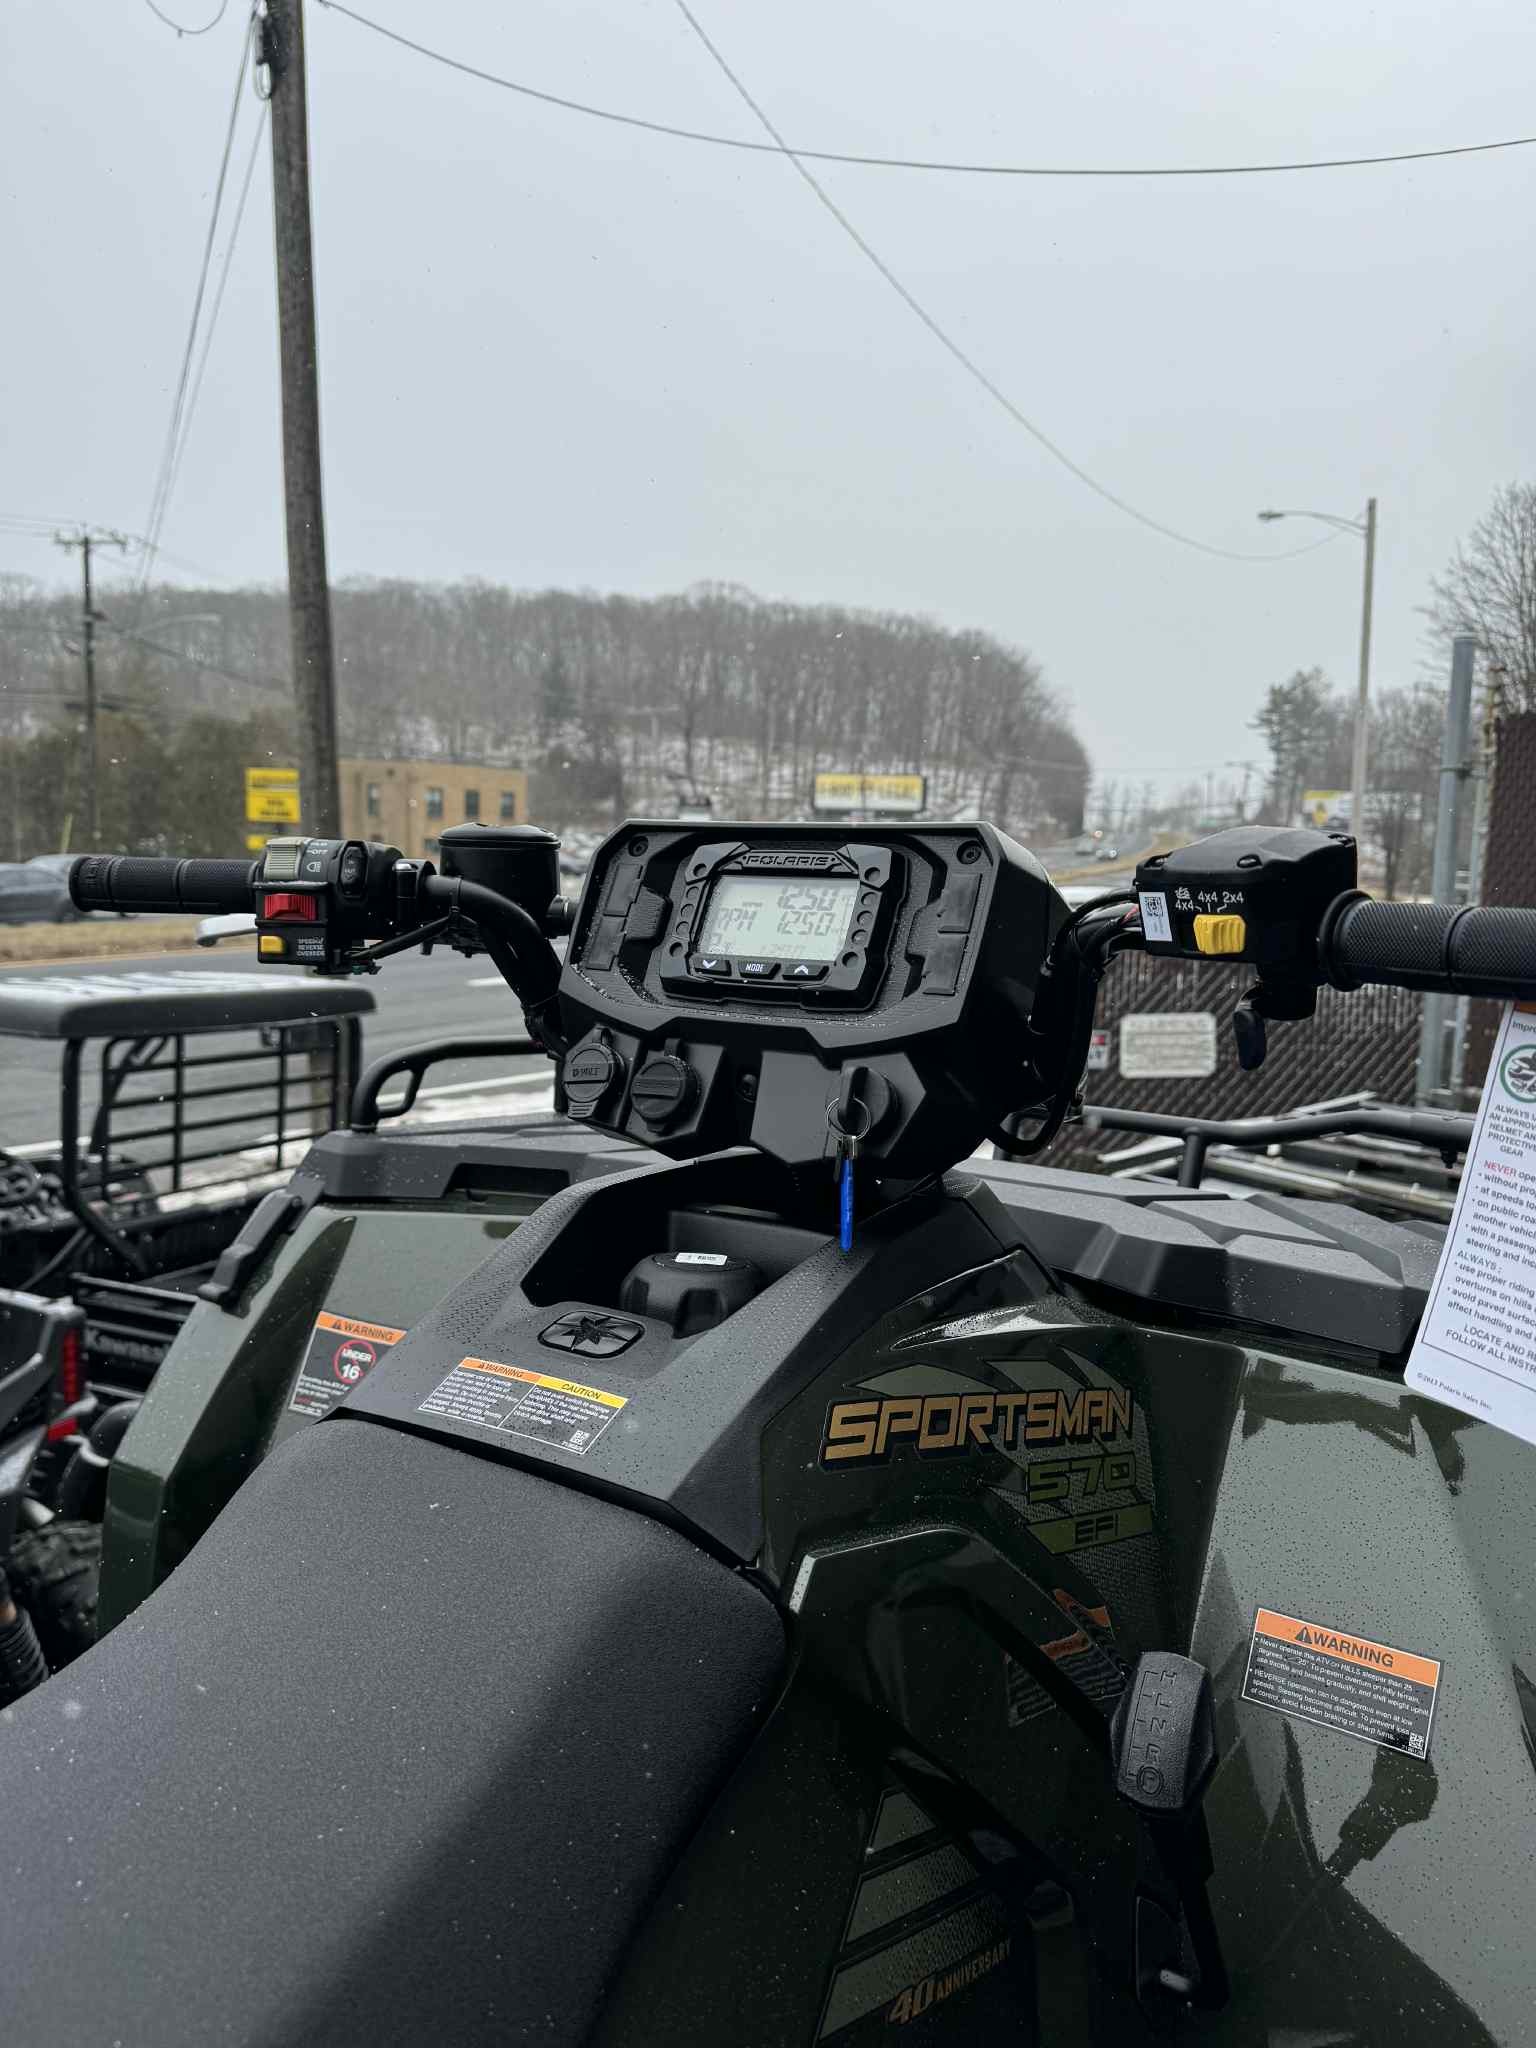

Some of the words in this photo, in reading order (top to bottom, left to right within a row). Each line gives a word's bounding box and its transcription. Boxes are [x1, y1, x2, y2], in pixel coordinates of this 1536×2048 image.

[746, 855, 829, 867] POLARIS
[1175, 899, 1194, 911] 4x4
[1198, 890, 1218, 903] 4x4
[1222, 890, 1244, 903] 2x4
[777, 911, 835, 936] 1250
[745, 963, 765, 973] MODE
[1494, 1104, 1530, 1119] ALWAYS
[1499, 1144, 1524, 1157] GEAR
[1484, 1160, 1517, 1177] NEVER
[1484, 1174, 1518, 1190] without
[1519, 1185, 1536, 1199] pro
[1491, 1190, 1524, 1206] speeds
[1477, 1199, 1489, 1208] on
[1490, 1203, 1520, 1218] public
[1473, 1212, 1507, 1229] another
[1466, 1238, 1501, 1257] steering
[1502, 1251, 1521, 1261] and
[1471, 1225, 1489, 1237] with
[1497, 1234, 1536, 1255] passeng
[1459, 1263, 1476, 1274] use
[1477, 1270, 1507, 1286] proper
[1509, 1281, 1535, 1299] riding
[1455, 1276, 1498, 1297] overturns
[1499, 1292, 1511, 1302] on
[1513, 1296, 1533, 1311] hills
[1452, 1289, 1477, 1303] avoid
[1477, 1299, 1506, 1314] paved
[1507, 1310, 1536, 1327] surfac
[1448, 1300, 1472, 1315] affect
[1474, 1309, 1513, 1333] handling
[1514, 1327, 1533, 1340] and
[344, 1322, 395, 1341] WARNING
[1464, 1323, 1503, 1346] LOCATE
[1504, 1341, 1526, 1355] AND
[1446, 1328, 1486, 1351] FOLLOW
[1487, 1347, 1506, 1361] ALL
[341, 1348, 372, 1362] UNDER
[341, 1363, 361, 1379] 16
[485, 1363, 524, 1378] WARNING
[561, 1383, 601, 1400] CAUTION
[823, 1389, 1133, 1461] SPORTSMAN
[1026, 1450, 1138, 1504] 570
[1075, 1516, 1120, 1545] EFI
[1313, 1631, 1394, 1668] WARNING
[1358, 1688, 1371, 1697] and
[1150, 1716, 1166, 1737] N
[1360, 1713, 1368, 1721] To
[1369, 1716, 1395, 1731] prevent
[889, 1978, 934, 2024] 40
